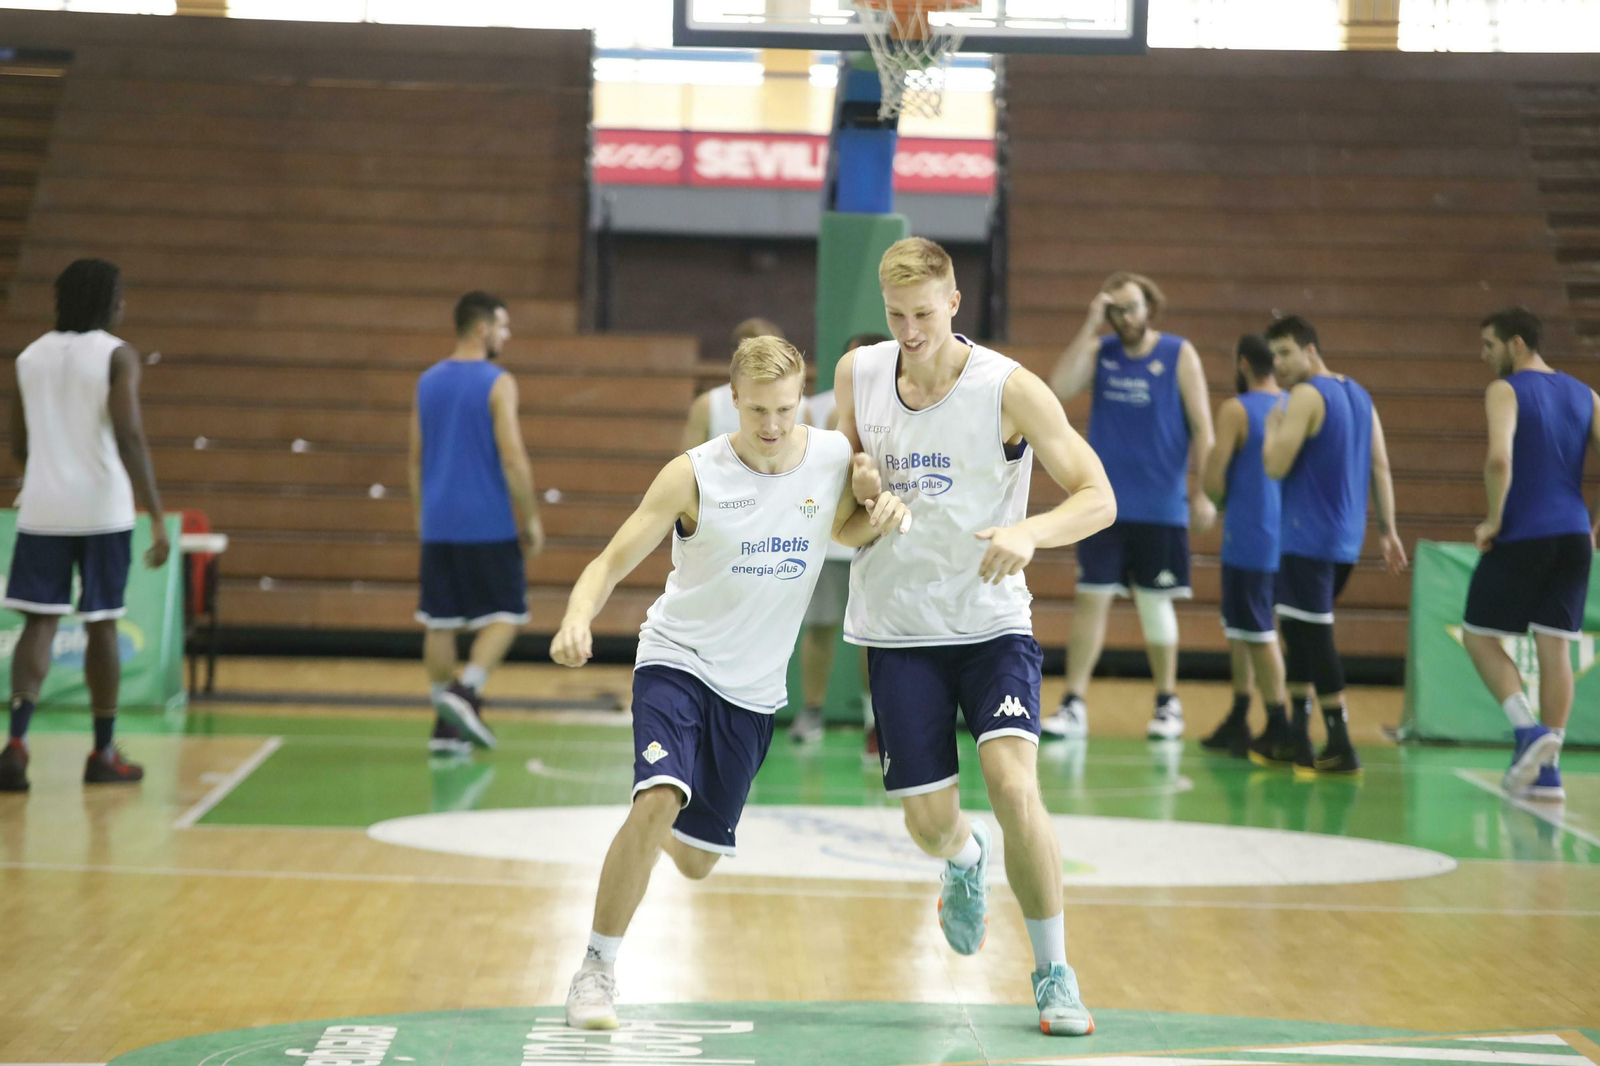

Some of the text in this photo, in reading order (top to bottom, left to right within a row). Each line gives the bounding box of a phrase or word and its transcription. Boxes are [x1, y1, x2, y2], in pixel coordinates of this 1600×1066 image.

[921, 479, 943, 491] plus
[719, 498, 756, 510] Kappa
[776, 563, 799, 575] plus
